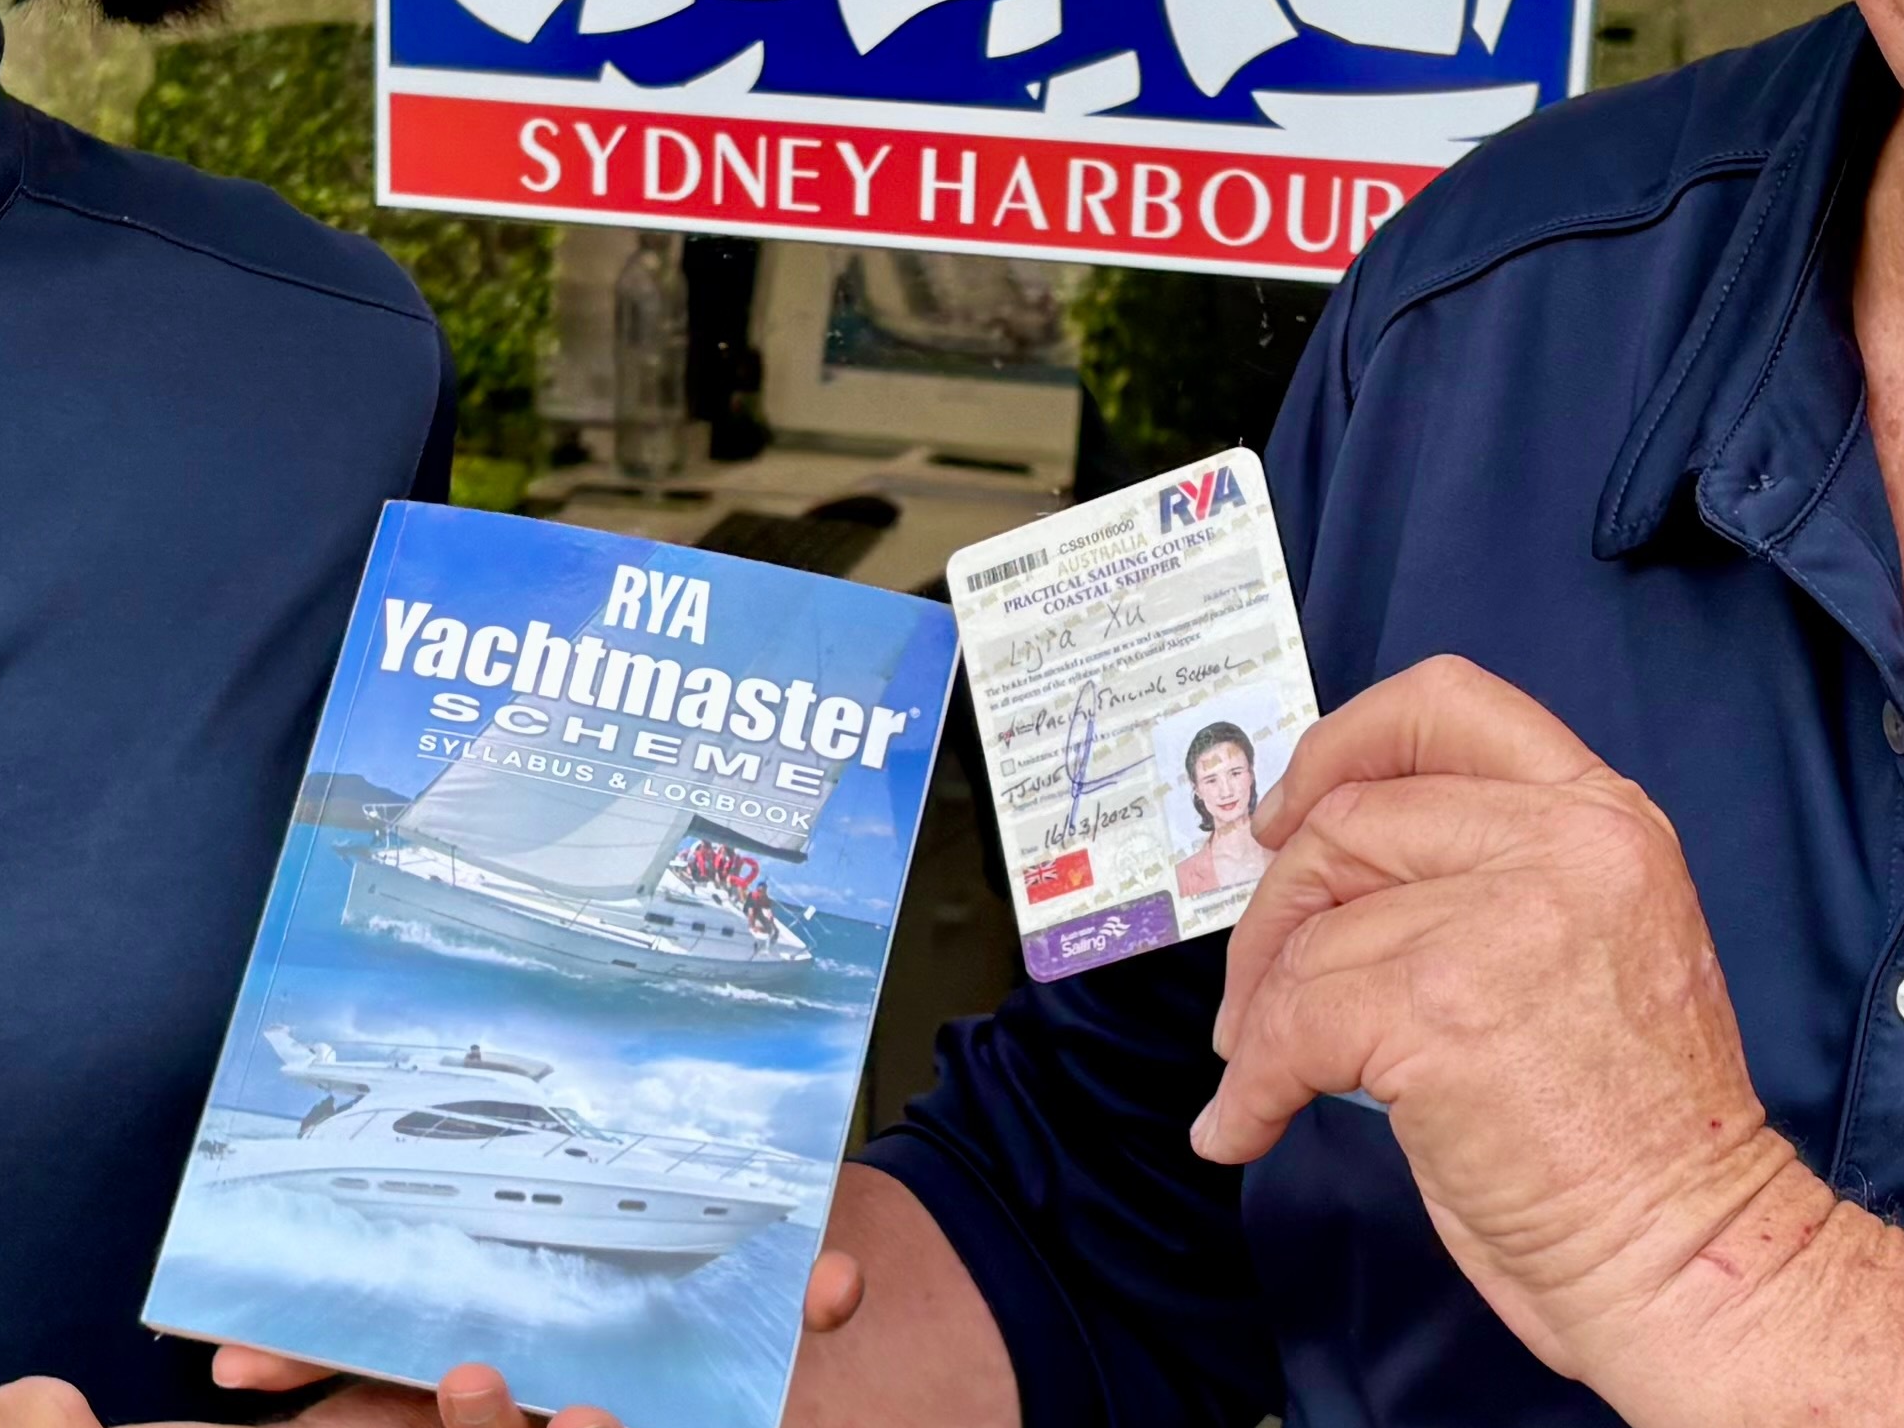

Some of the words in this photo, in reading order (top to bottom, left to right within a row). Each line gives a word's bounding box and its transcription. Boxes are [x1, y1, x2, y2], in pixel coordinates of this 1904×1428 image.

[519, 118, 892, 221] SYDNEY
[918, 151, 1405, 256] HARBOUR
[1159, 465, 1248, 535] RYA
[1002, 573, 1086, 614] PRACTICAL
[1085, 550, 1150, 584] SAILING
[1150, 525, 1218, 560] COURSE
[1041, 580, 1113, 617] COASTAL
[1113, 555, 1182, 591] SKIPPER
[1058, 532, 1149, 576] AUSTRALIA
[602, 563, 711, 645] RYA
[1103, 603, 1146, 640] Xu
[418, 732, 596, 786] SYLLABUS
[608, 771, 629, 791] &
[642, 774, 813, 834] LOGBOOK
[429, 692, 824, 796] SCHEME
